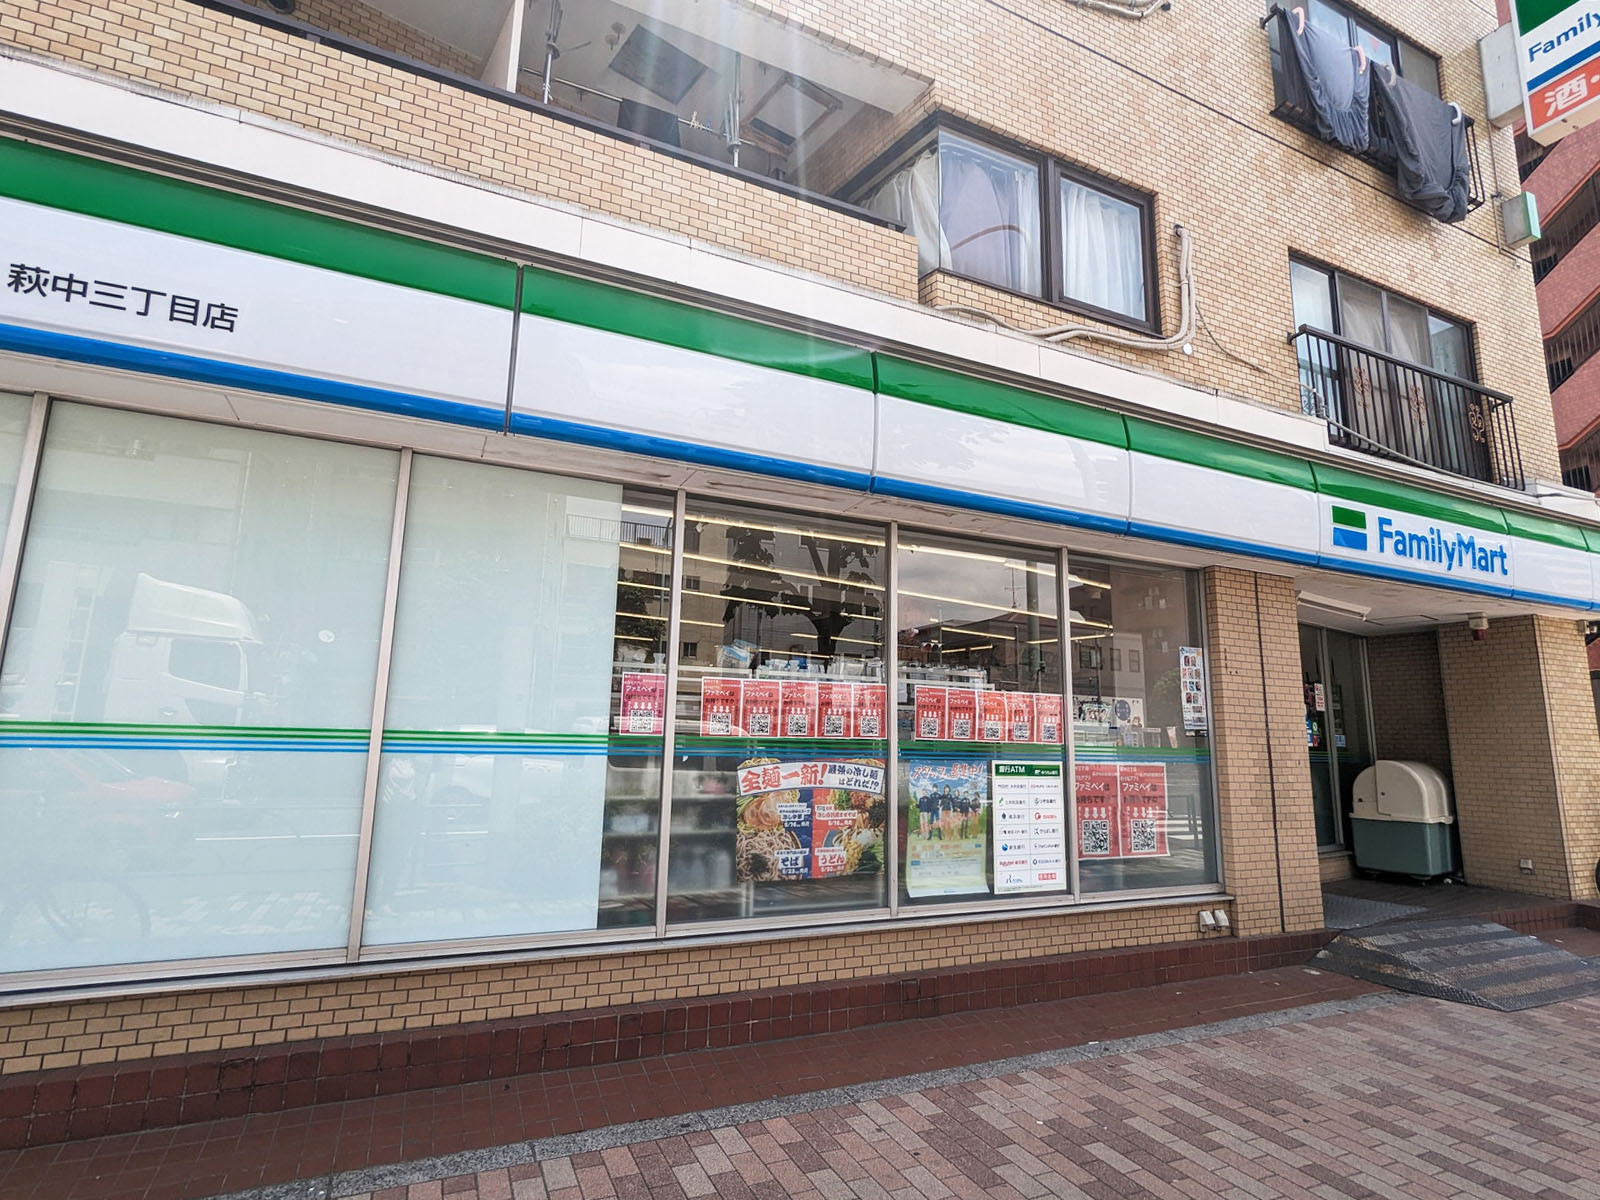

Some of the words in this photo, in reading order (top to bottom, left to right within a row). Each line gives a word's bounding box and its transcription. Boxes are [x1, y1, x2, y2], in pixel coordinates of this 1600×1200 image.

[7, 262, 239, 333] 萩中三丁目店
[1377, 516, 1509, 576] FamilyMart
[781, 856, 799, 867] そば
[821, 854, 845, 864] うどん
